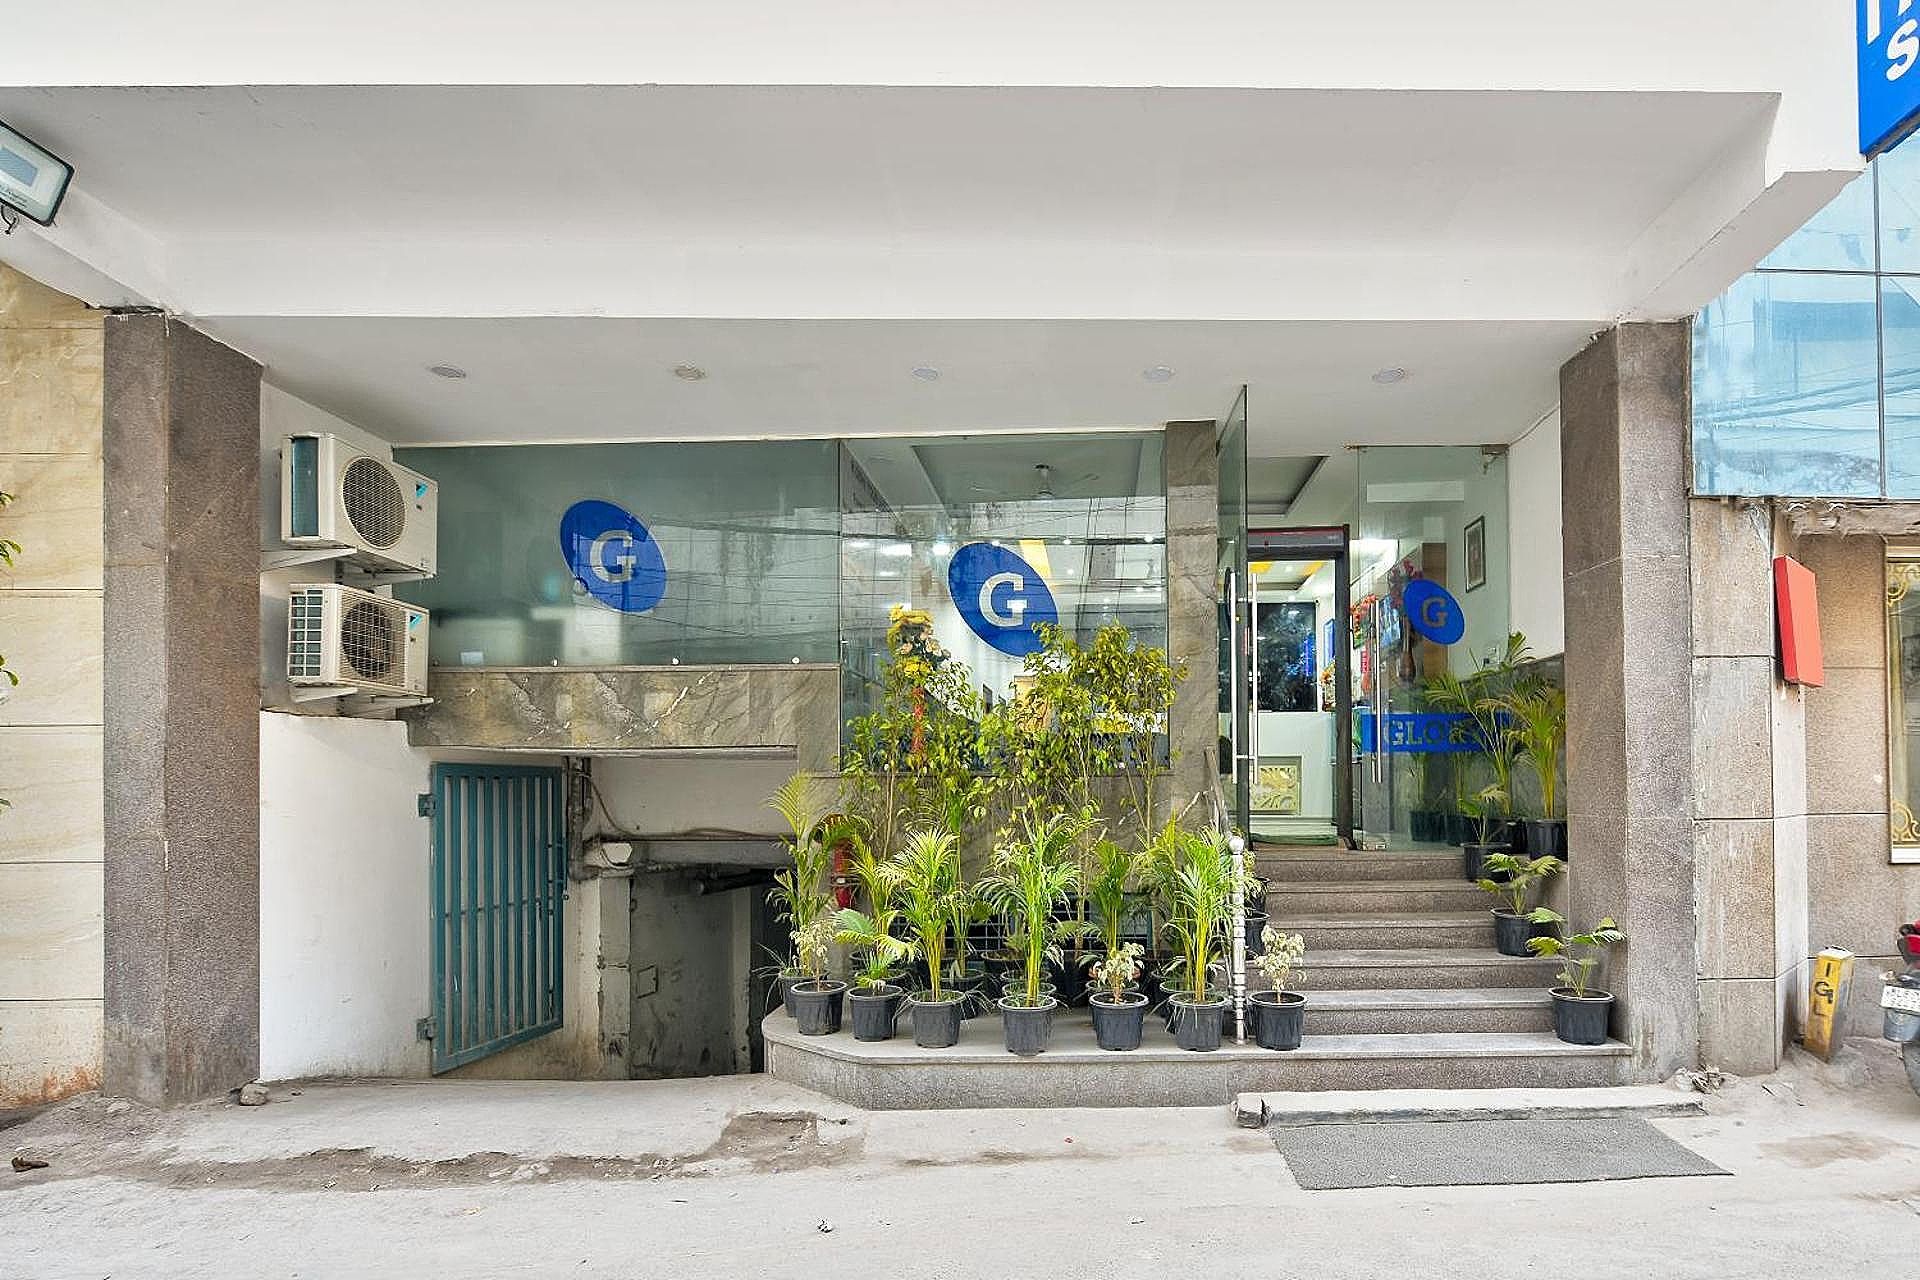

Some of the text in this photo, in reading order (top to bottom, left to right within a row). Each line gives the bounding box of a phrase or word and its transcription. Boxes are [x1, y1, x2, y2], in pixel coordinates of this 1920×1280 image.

[590, 529, 636, 583] G
[979, 572, 1028, 627] G
[1422, 596, 1448, 628] G
[1383, 719, 1468, 745] GLO
